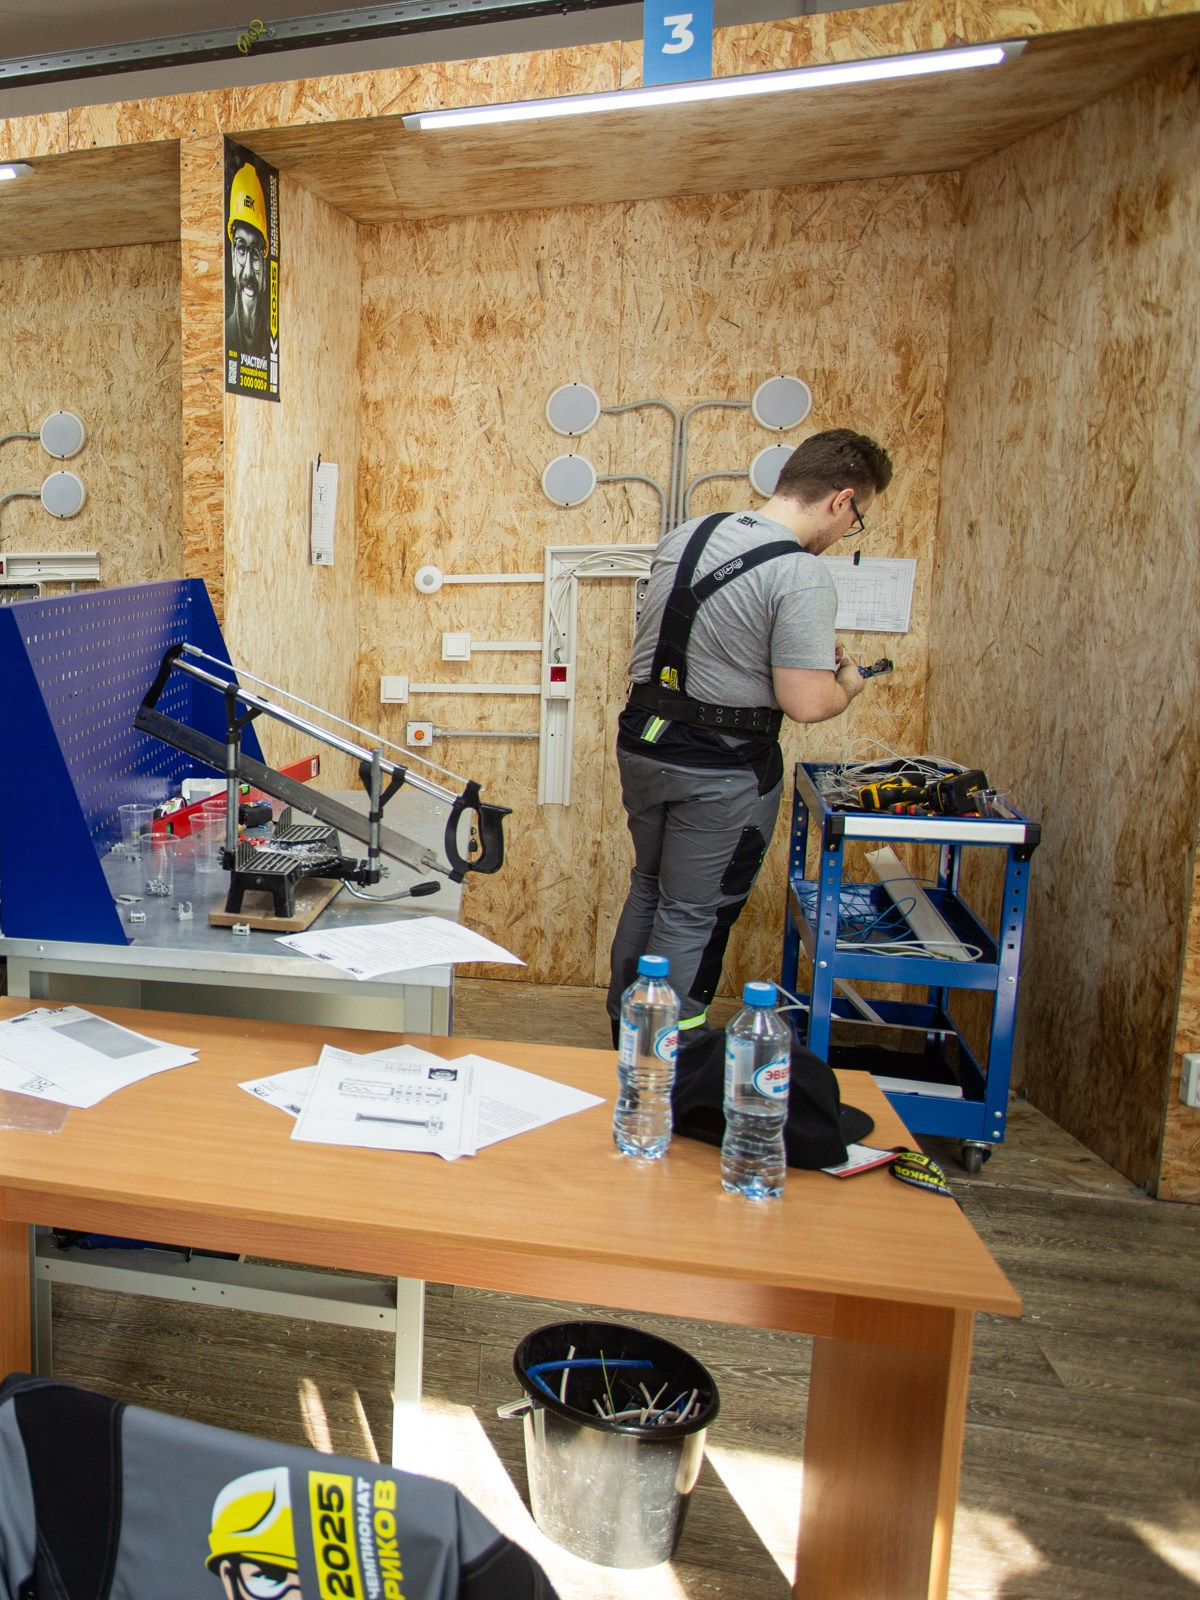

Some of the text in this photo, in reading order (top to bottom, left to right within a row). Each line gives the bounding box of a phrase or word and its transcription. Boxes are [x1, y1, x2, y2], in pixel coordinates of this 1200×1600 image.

[661, 13, 694, 54] 3
[736, 515, 757, 528] IEK
[317, 1483, 355, 1598] 2025
[357, 1476, 382, 1600] ЧЕМПИОНАТ
